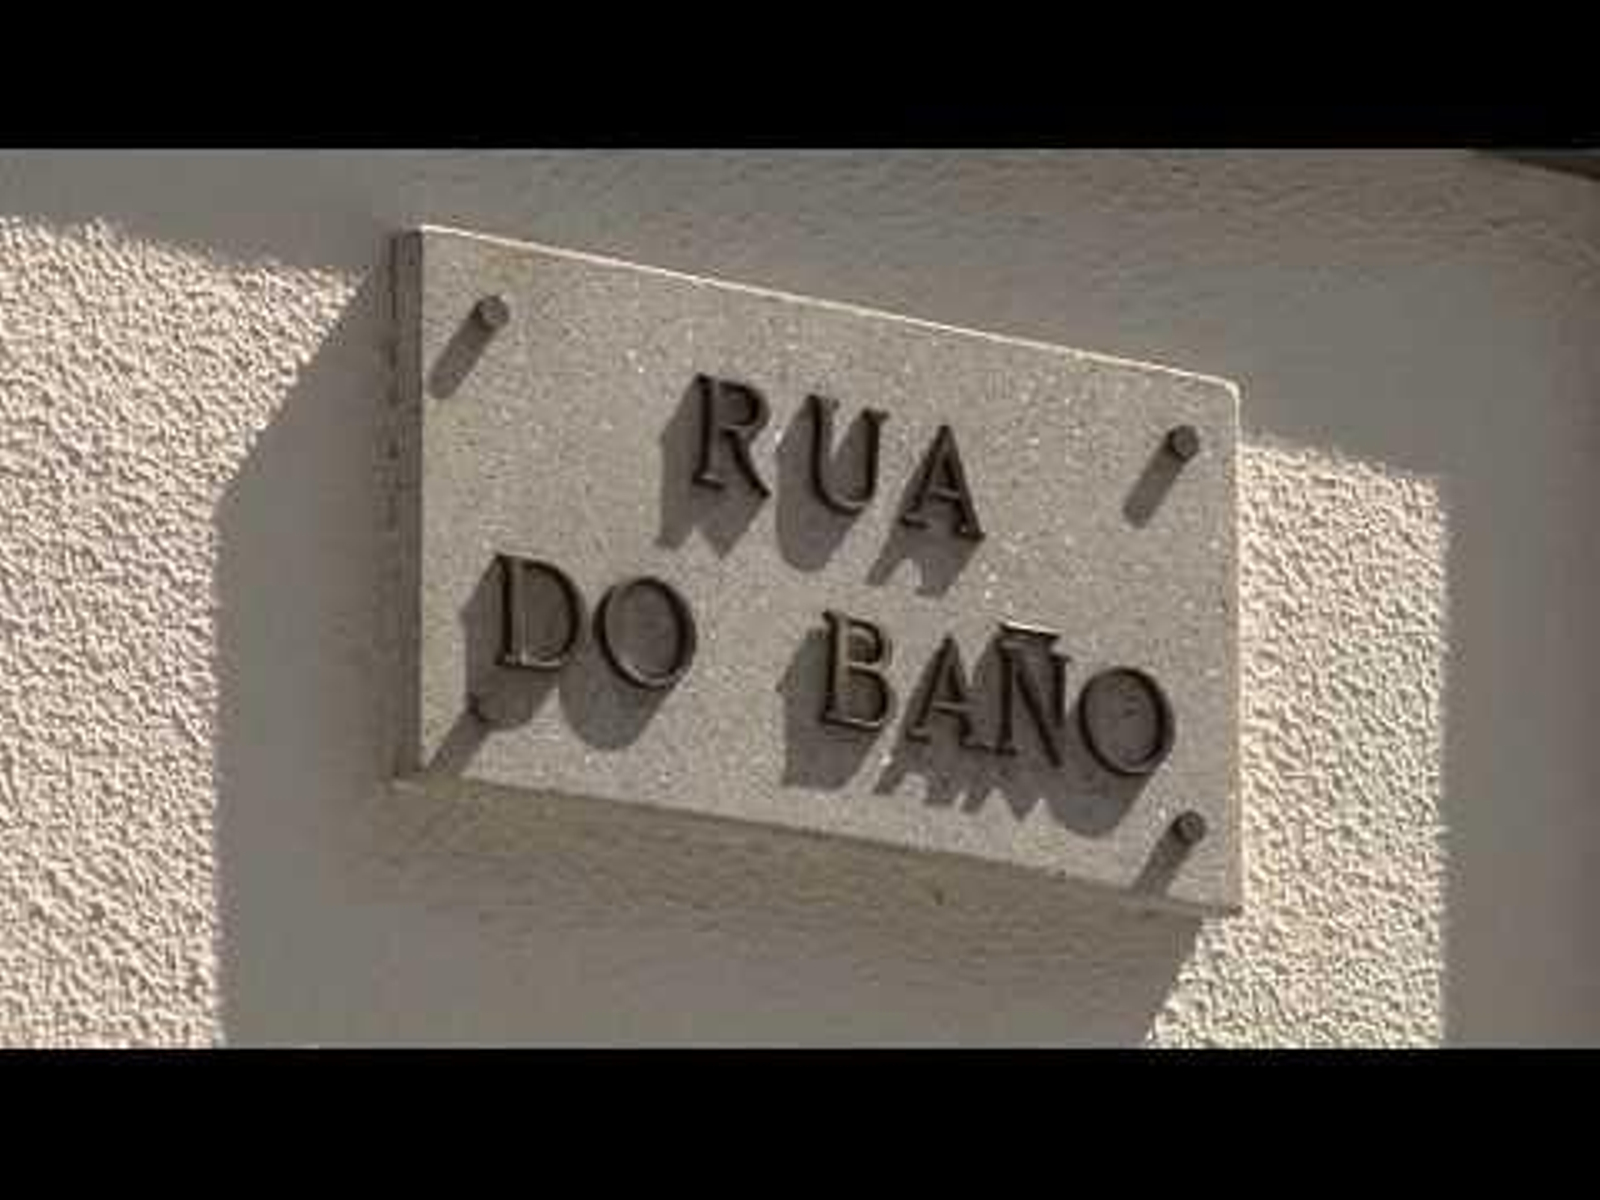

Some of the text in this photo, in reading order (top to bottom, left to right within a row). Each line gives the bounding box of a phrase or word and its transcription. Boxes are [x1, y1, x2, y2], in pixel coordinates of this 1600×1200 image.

[691, 372, 985, 541] RUA
[493, 552, 1175, 777] DO BAÑO
